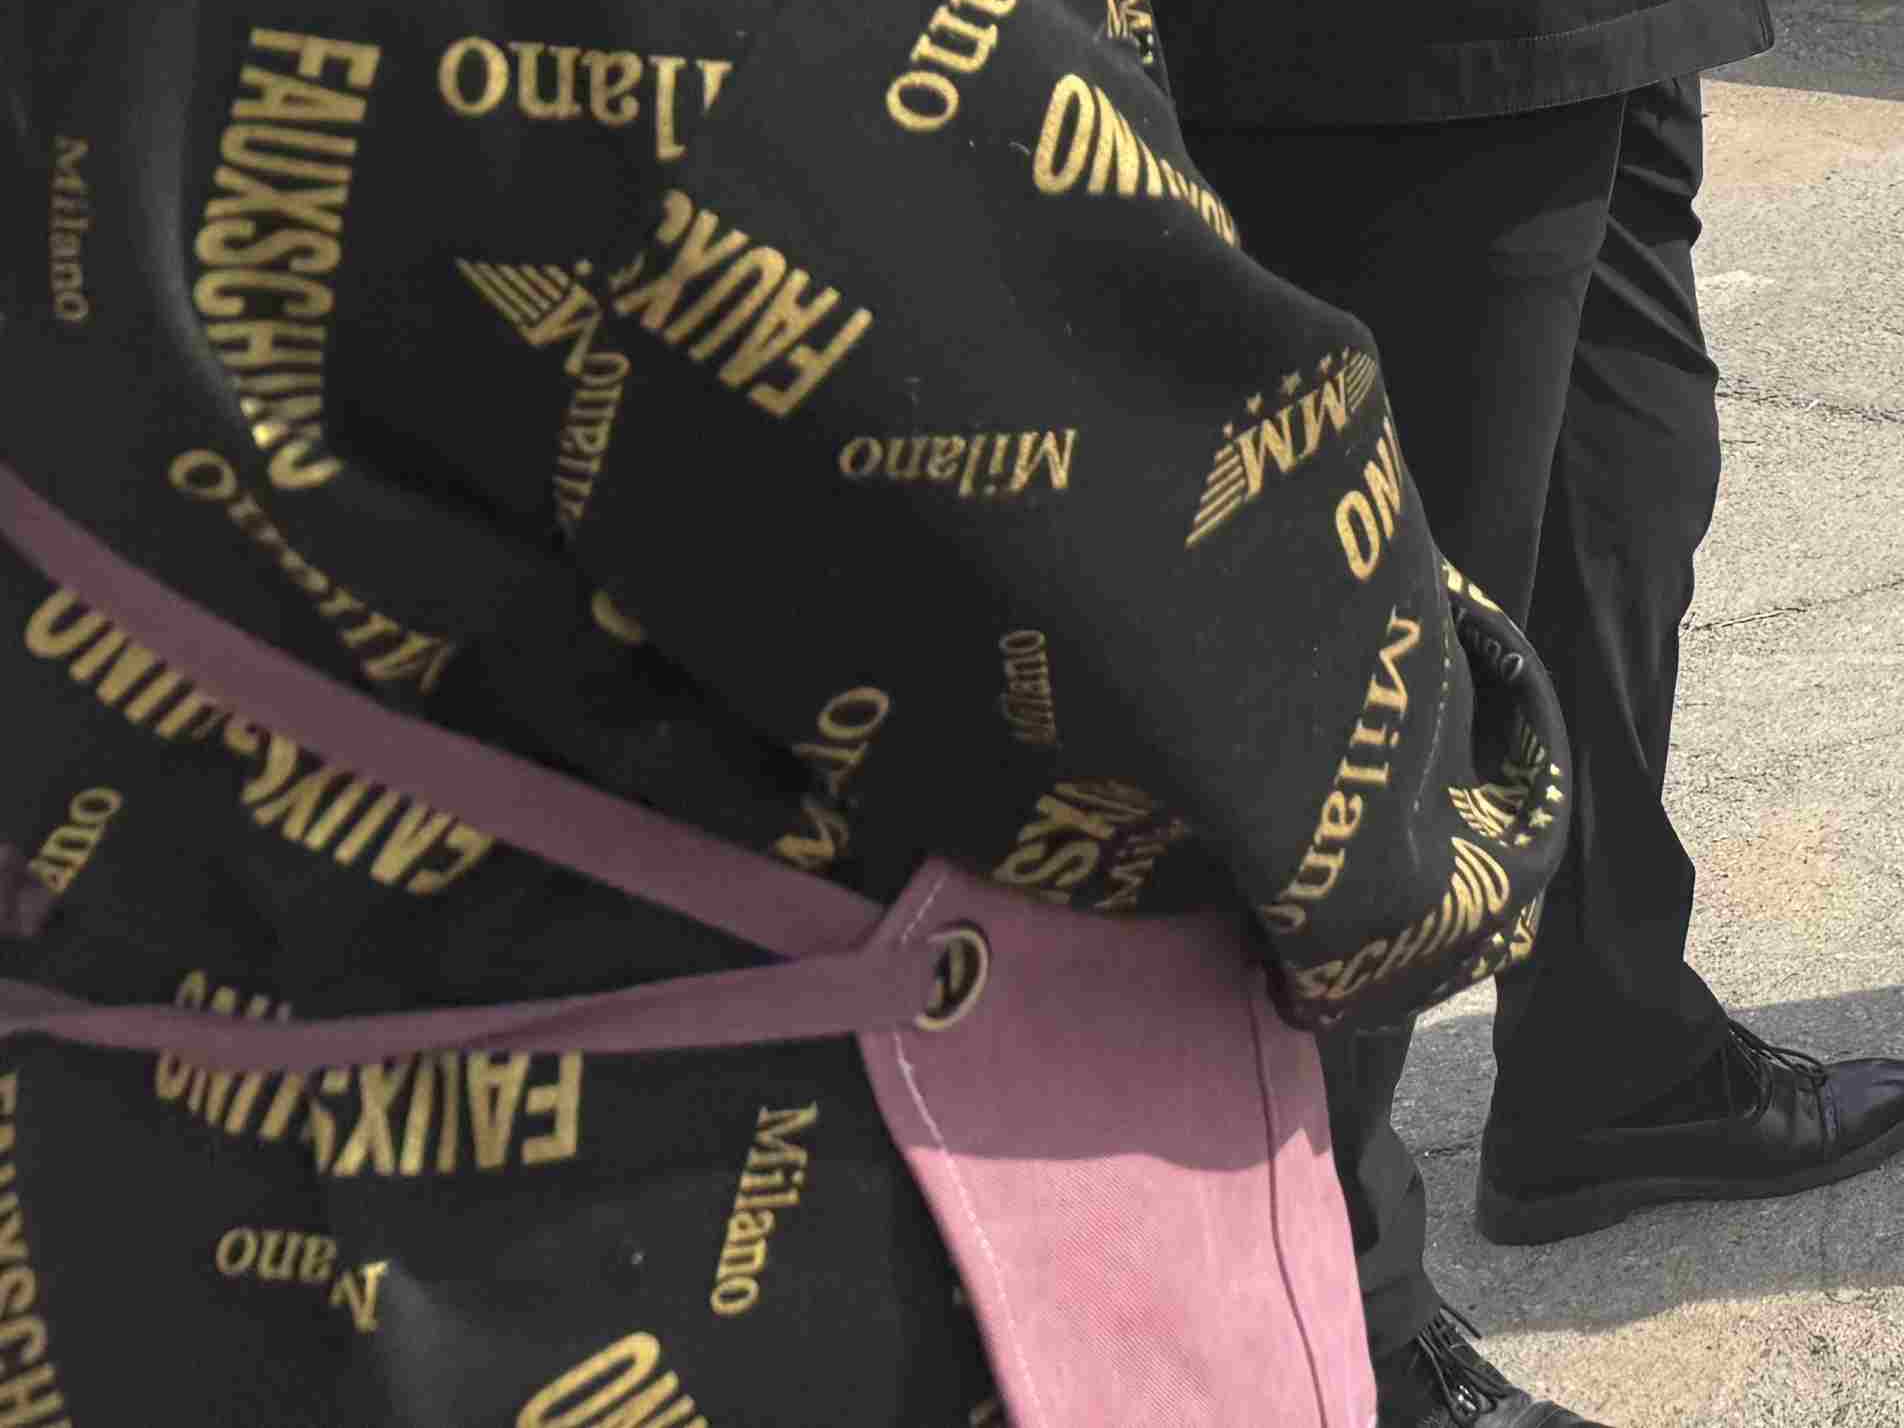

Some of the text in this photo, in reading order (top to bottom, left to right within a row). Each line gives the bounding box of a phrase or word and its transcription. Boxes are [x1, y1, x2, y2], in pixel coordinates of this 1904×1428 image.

[51, 135, 90, 322] Milano
[838, 428, 1078, 498] Milano
[711, 1100, 819, 1315] Milano
